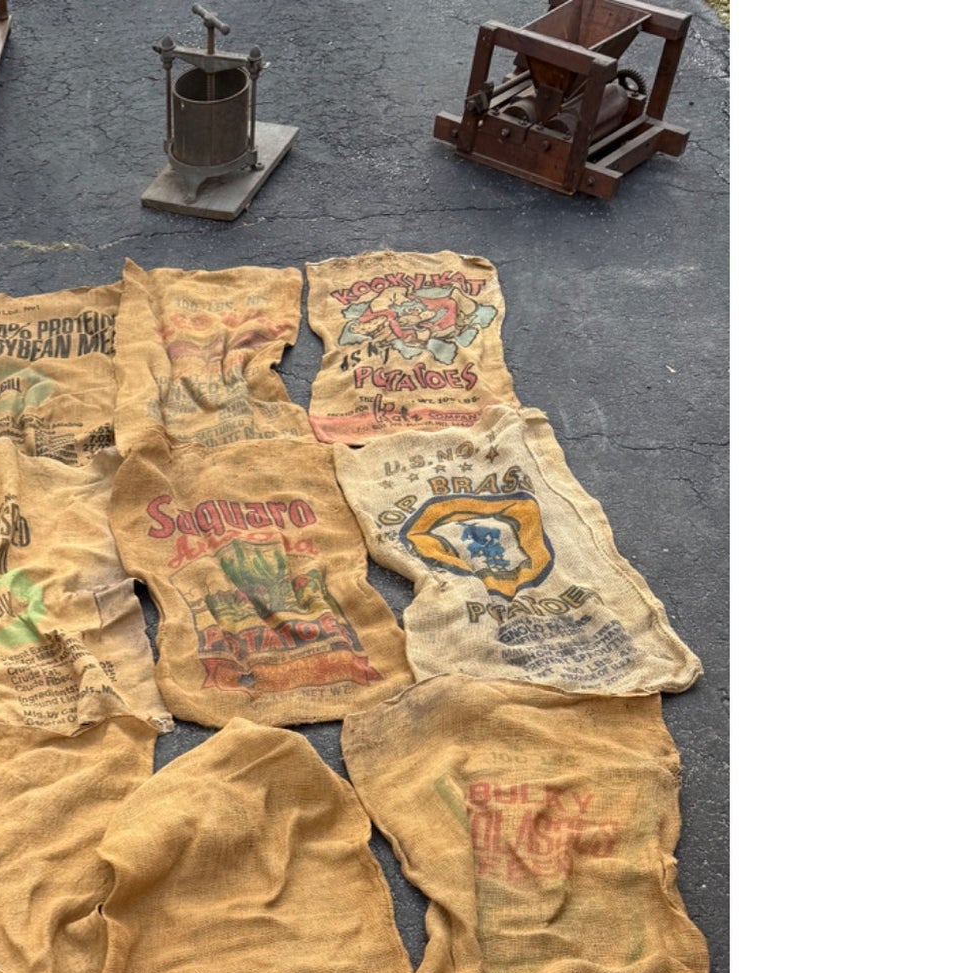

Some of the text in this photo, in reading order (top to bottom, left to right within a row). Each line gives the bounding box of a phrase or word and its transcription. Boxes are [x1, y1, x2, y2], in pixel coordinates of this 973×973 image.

[331, 271, 486, 305] KOOKY KAT
[354, 363, 478, 391] POTATOES
[384, 454, 433, 476] U.S.
[147, 495, 317, 539] Saguaro
